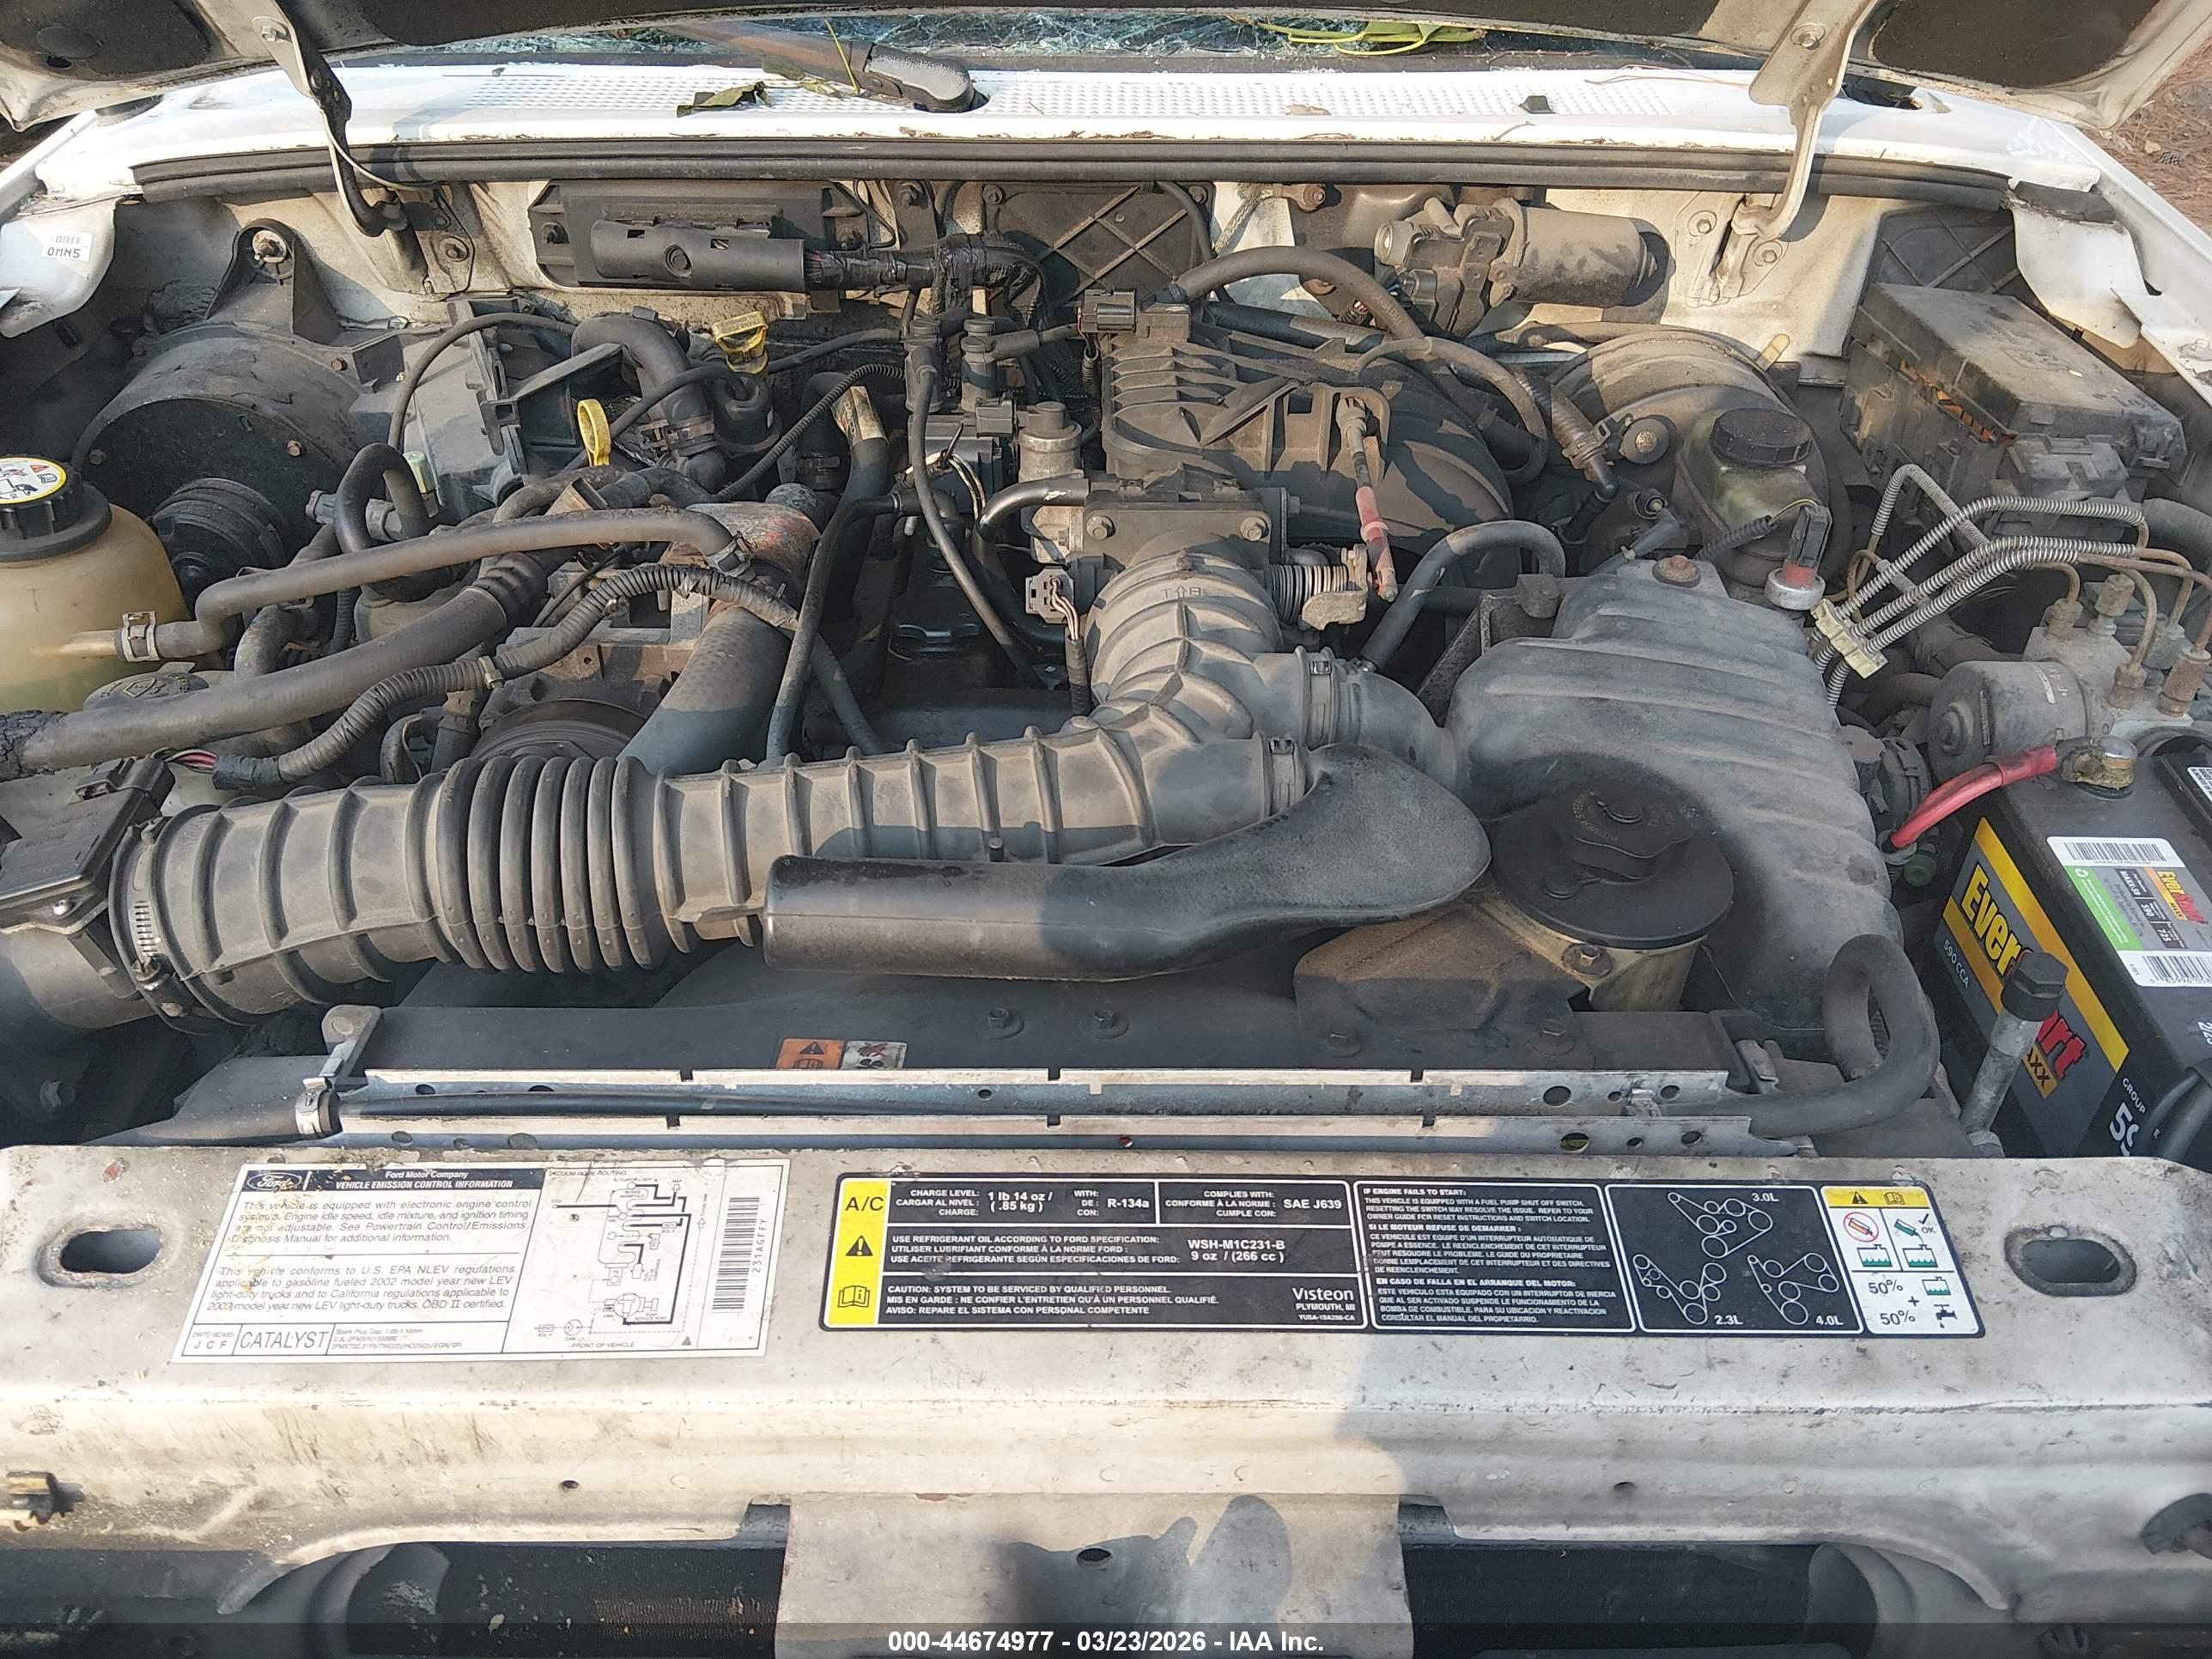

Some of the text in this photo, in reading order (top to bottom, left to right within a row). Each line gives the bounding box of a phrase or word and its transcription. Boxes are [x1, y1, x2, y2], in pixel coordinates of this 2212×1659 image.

[2141, 904, 2154, 917] 590
[2156, 929, 2172, 942] 725
[1943, 940, 1970, 989] 590 CCA
[2123, 1078, 2146, 1114] GROUP
[988, 1192, 994, 1200] 1
[998, 1192, 1010, 1200] lb
[1013, 1192, 1028, 1200] 14
[1752, 1192, 1779, 1202] 3.0L
[845, 1196, 884, 1211] A/C
[1019, 1202, 1036, 1212] kg
[1108, 1199, 1149, 1207] R-134a
[1284, 1200, 1341, 1209] SAE J639
[1921, 1225, 1936, 1234] OK
[1191, 1252, 1199, 1261] 9
[1231, 1252, 1258, 1262] (266
[290, 1267, 340, 1275] conforms
[389, 1266, 411, 1274] EPA
[416, 1265, 450, 1273] NLEV
[453, 1265, 515, 1275] regulations
[285, 1279, 330, 1289] gasoline
[334, 1277, 366, 1285] fueled
[400, 1277, 434, 1285] model
[436, 1279, 464, 1287] year
[489, 1276, 513, 1285] LEV
[1869, 1279, 1904, 1294] 50%
[1292, 1288, 1354, 1300] Visteon
[1714, 1315, 1743, 1325] 2.3L
[1816, 1315, 1844, 1326] 4.0L
[1880, 1310, 1916, 1326] 50%
[194, 1340, 201, 1349] J
[240, 1331, 329, 1348] CATALYST
